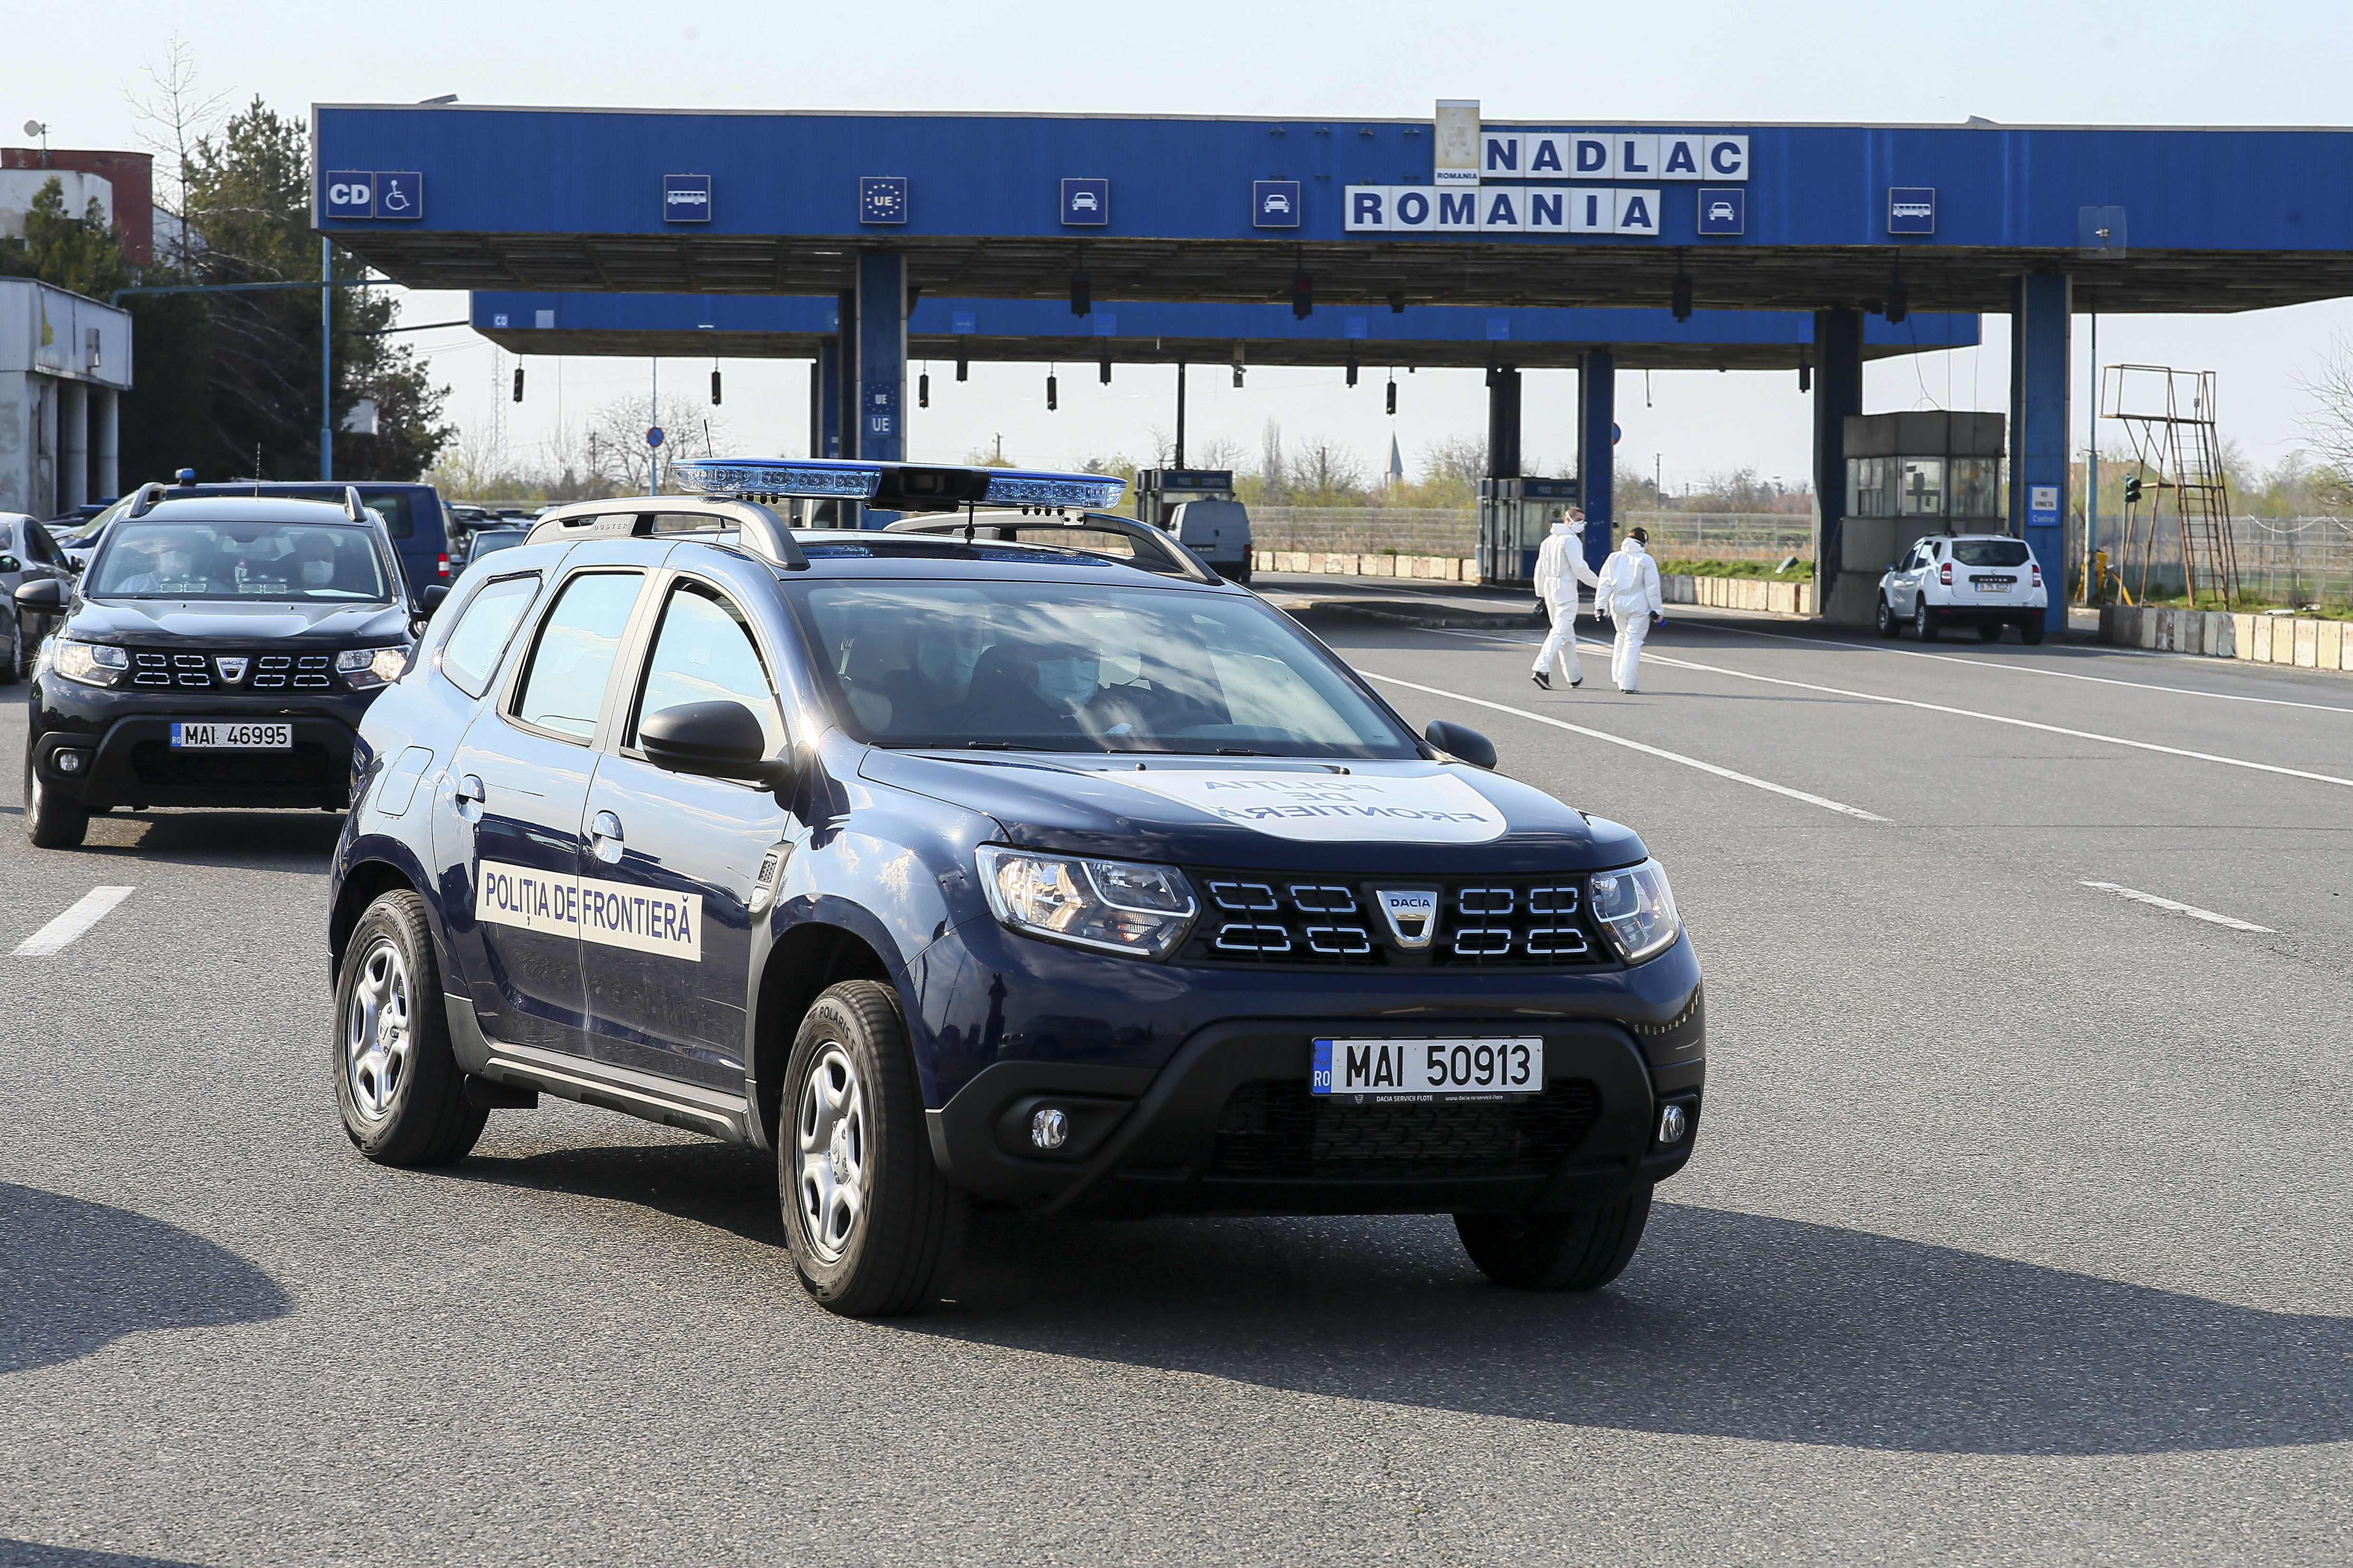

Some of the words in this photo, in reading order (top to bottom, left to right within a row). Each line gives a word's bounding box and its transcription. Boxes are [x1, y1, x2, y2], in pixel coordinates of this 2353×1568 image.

[1487, 139, 1741, 174] NADLAC
[329, 183, 370, 205] CD
[874, 196, 893, 206] UE
[1353, 192, 1651, 228] ROMANIA
[495, 316, 508, 326] CD
[875, 394, 888, 404] UE
[872, 417, 890, 432] UE
[185, 726, 215, 744] MAI
[227, 726, 287, 745] 46995
[1390, 899, 1431, 907] DACIA
[555, 884, 576, 923] DE
[583, 890, 691, 944] FRONTIERĂ
[819, 1006, 851, 1040] POLARIS
[1314, 1070, 1330, 1087] RO
[1346, 1045, 1403, 1087] MAI
[1427, 1044, 1531, 1086] 50913
